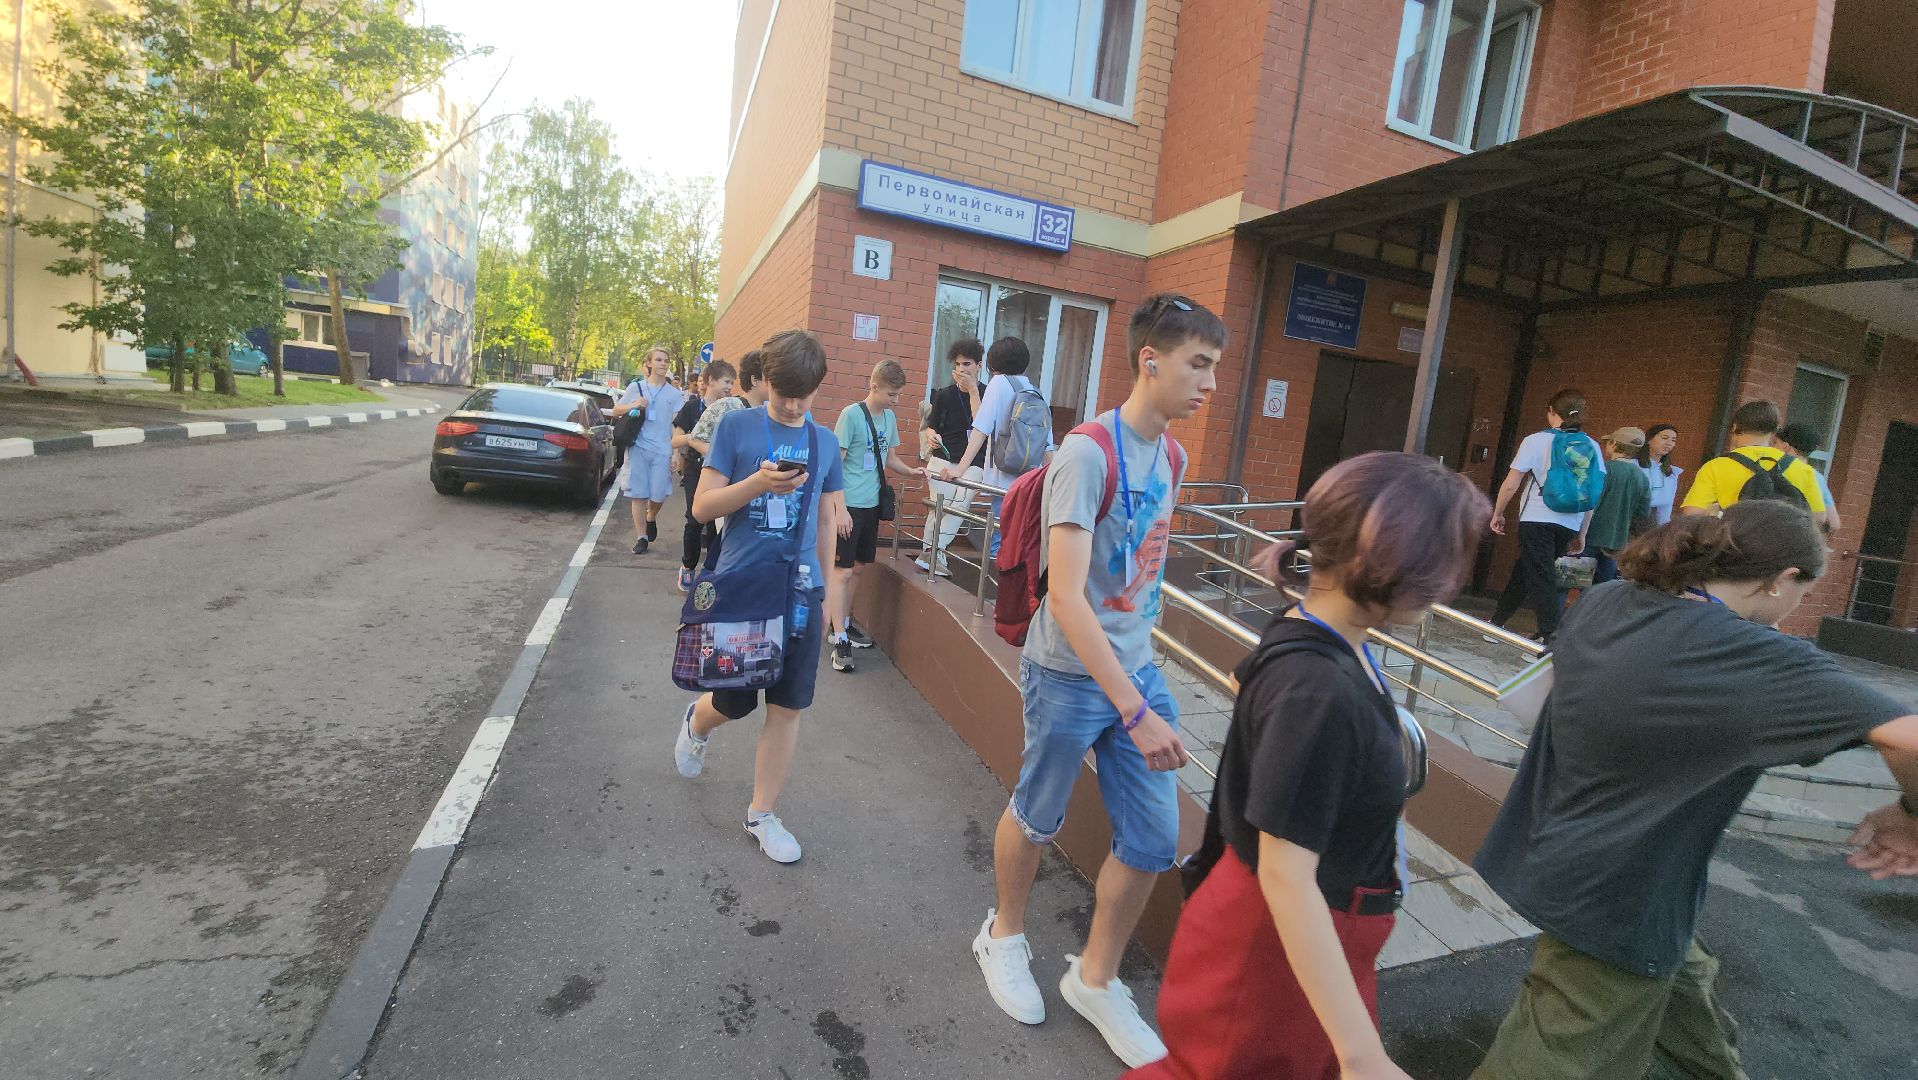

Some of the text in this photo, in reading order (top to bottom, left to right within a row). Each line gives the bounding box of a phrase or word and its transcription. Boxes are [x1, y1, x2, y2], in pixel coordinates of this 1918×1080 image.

[878, 173, 1026, 220] Первомайская
[923, 202, 982, 224] улица
[1041, 213, 1068, 236] 32
[864, 248, 880, 270] В
